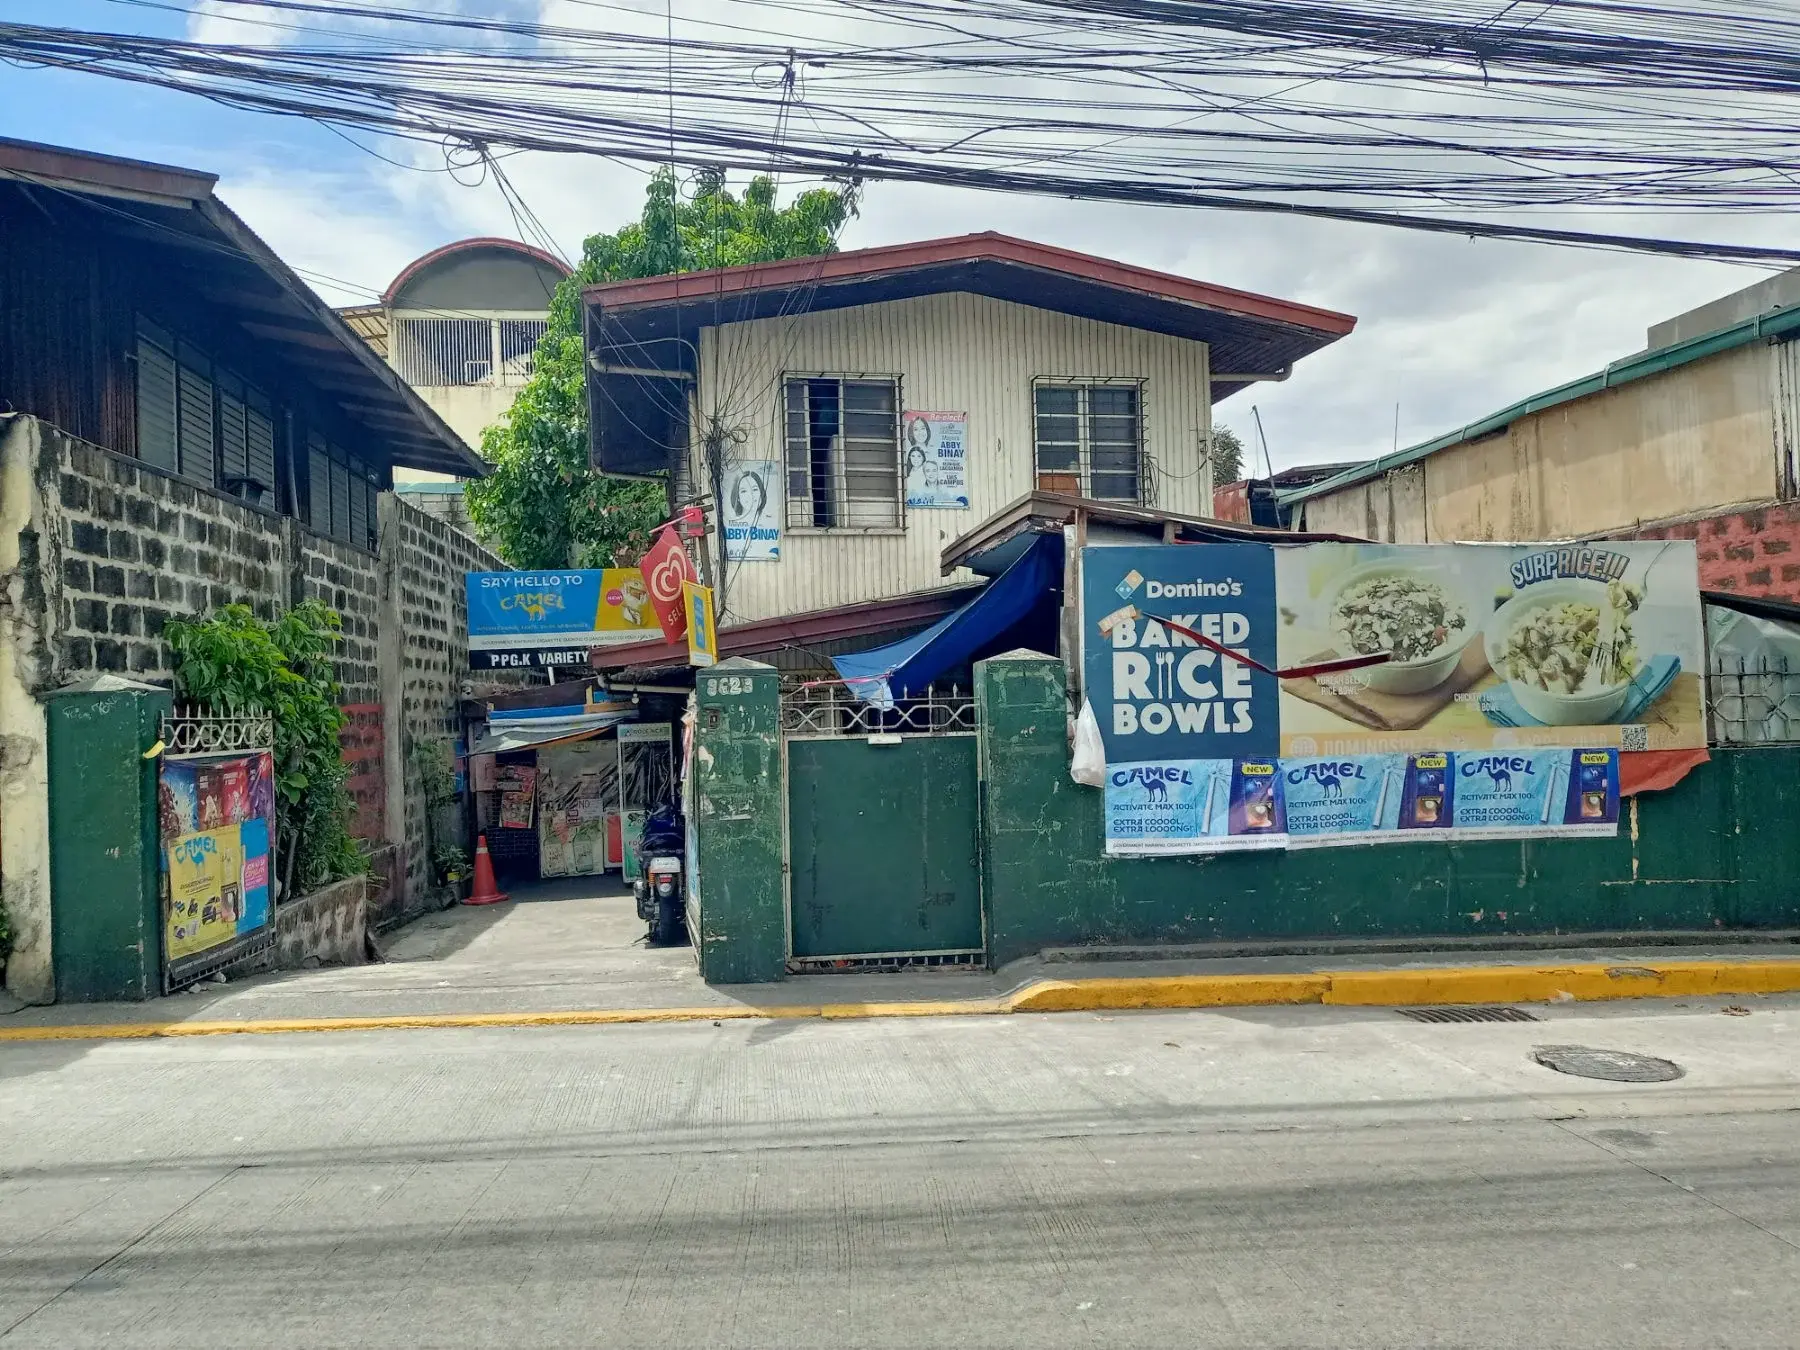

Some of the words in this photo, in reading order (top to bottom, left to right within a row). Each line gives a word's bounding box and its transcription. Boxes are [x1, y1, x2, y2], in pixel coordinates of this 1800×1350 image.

[938, 449, 965, 458] BINAY
[941, 441, 961, 449] ABBY
[750, 528, 779, 540] BINAY
[1510, 548, 1631, 589] SURPRICE!!!
[481, 577, 512, 588] SAY
[514, 576, 560, 587] HELLO
[564, 575, 583, 585] TO
[1146, 578, 1244, 599] Domino's
[500, 592, 566, 610] CAMEL
[1112, 612, 1250, 649] BAKED
[538, 651, 589, 665] VARIETY
[1113, 648, 1252, 700] RICE
[1113, 701, 1253, 735] BOWLS
[1287, 762, 1366, 785] CAMEL
[1461, 757, 1535, 777] CAMEL
[1112, 767, 1193, 787] CAMEL
[1288, 800, 1328, 809] ACTIVATE
[1460, 793, 1498, 801] ACTIVATE
[1289, 815, 1318, 823] EXTRA
[175, 836, 218, 864] CAMEL
